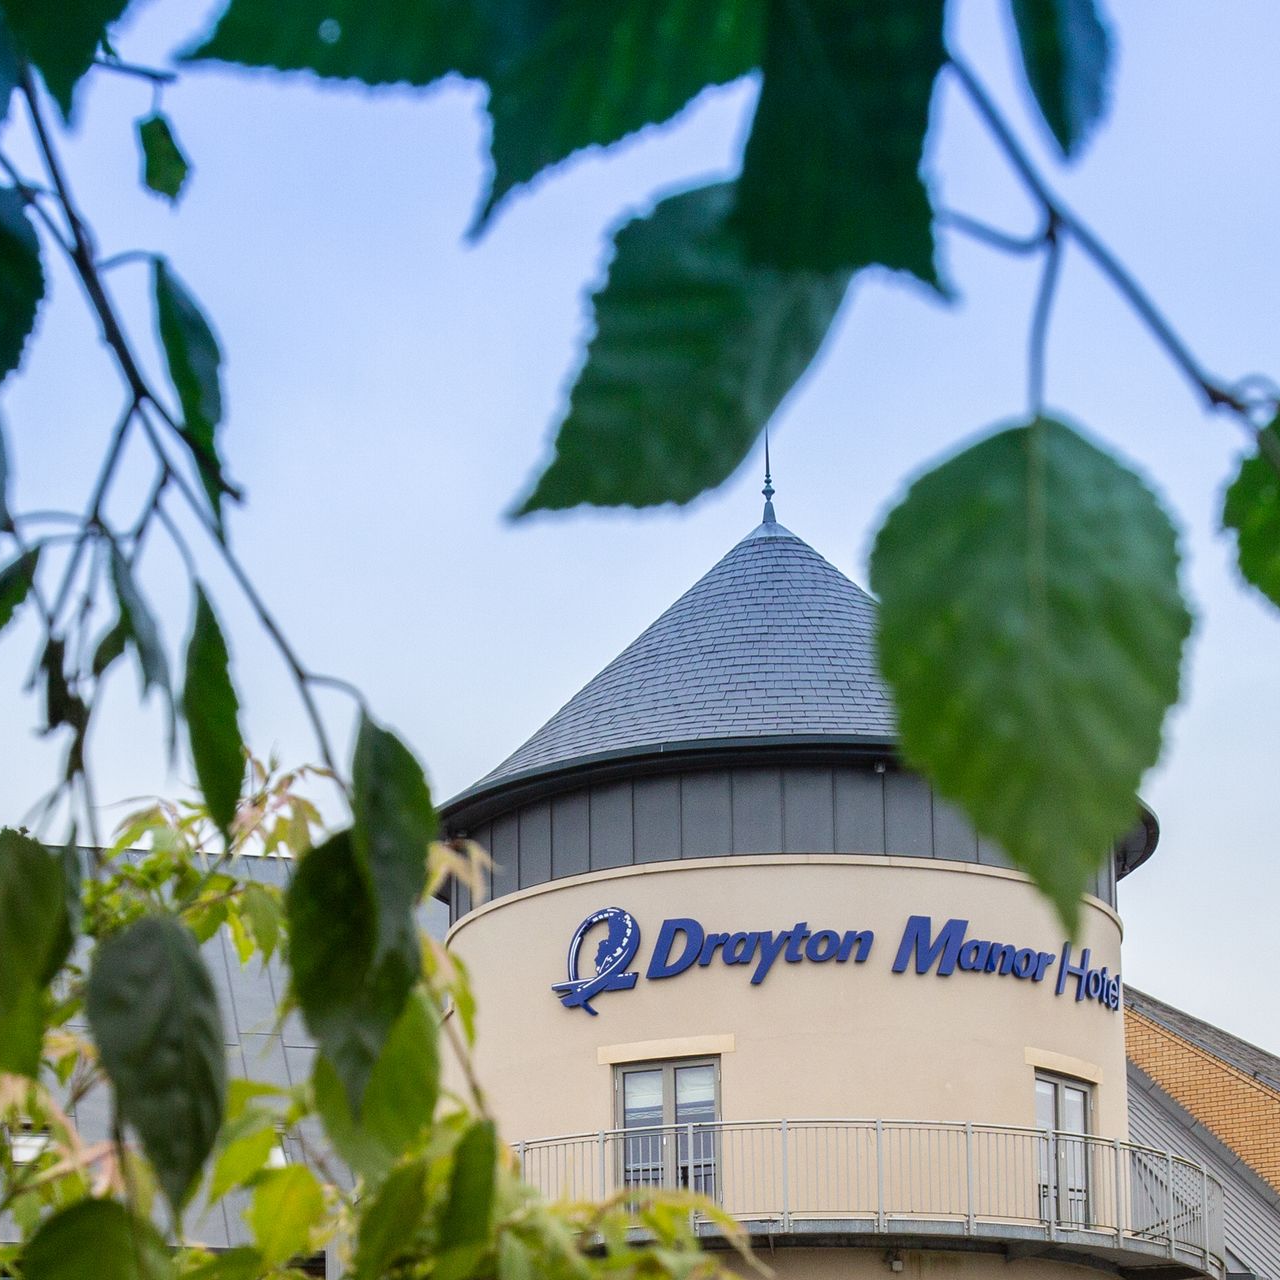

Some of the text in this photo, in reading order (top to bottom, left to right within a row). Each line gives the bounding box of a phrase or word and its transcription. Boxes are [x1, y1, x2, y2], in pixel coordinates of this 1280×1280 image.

[645, 915, 1120, 1012] Drayton Manor Hotel
